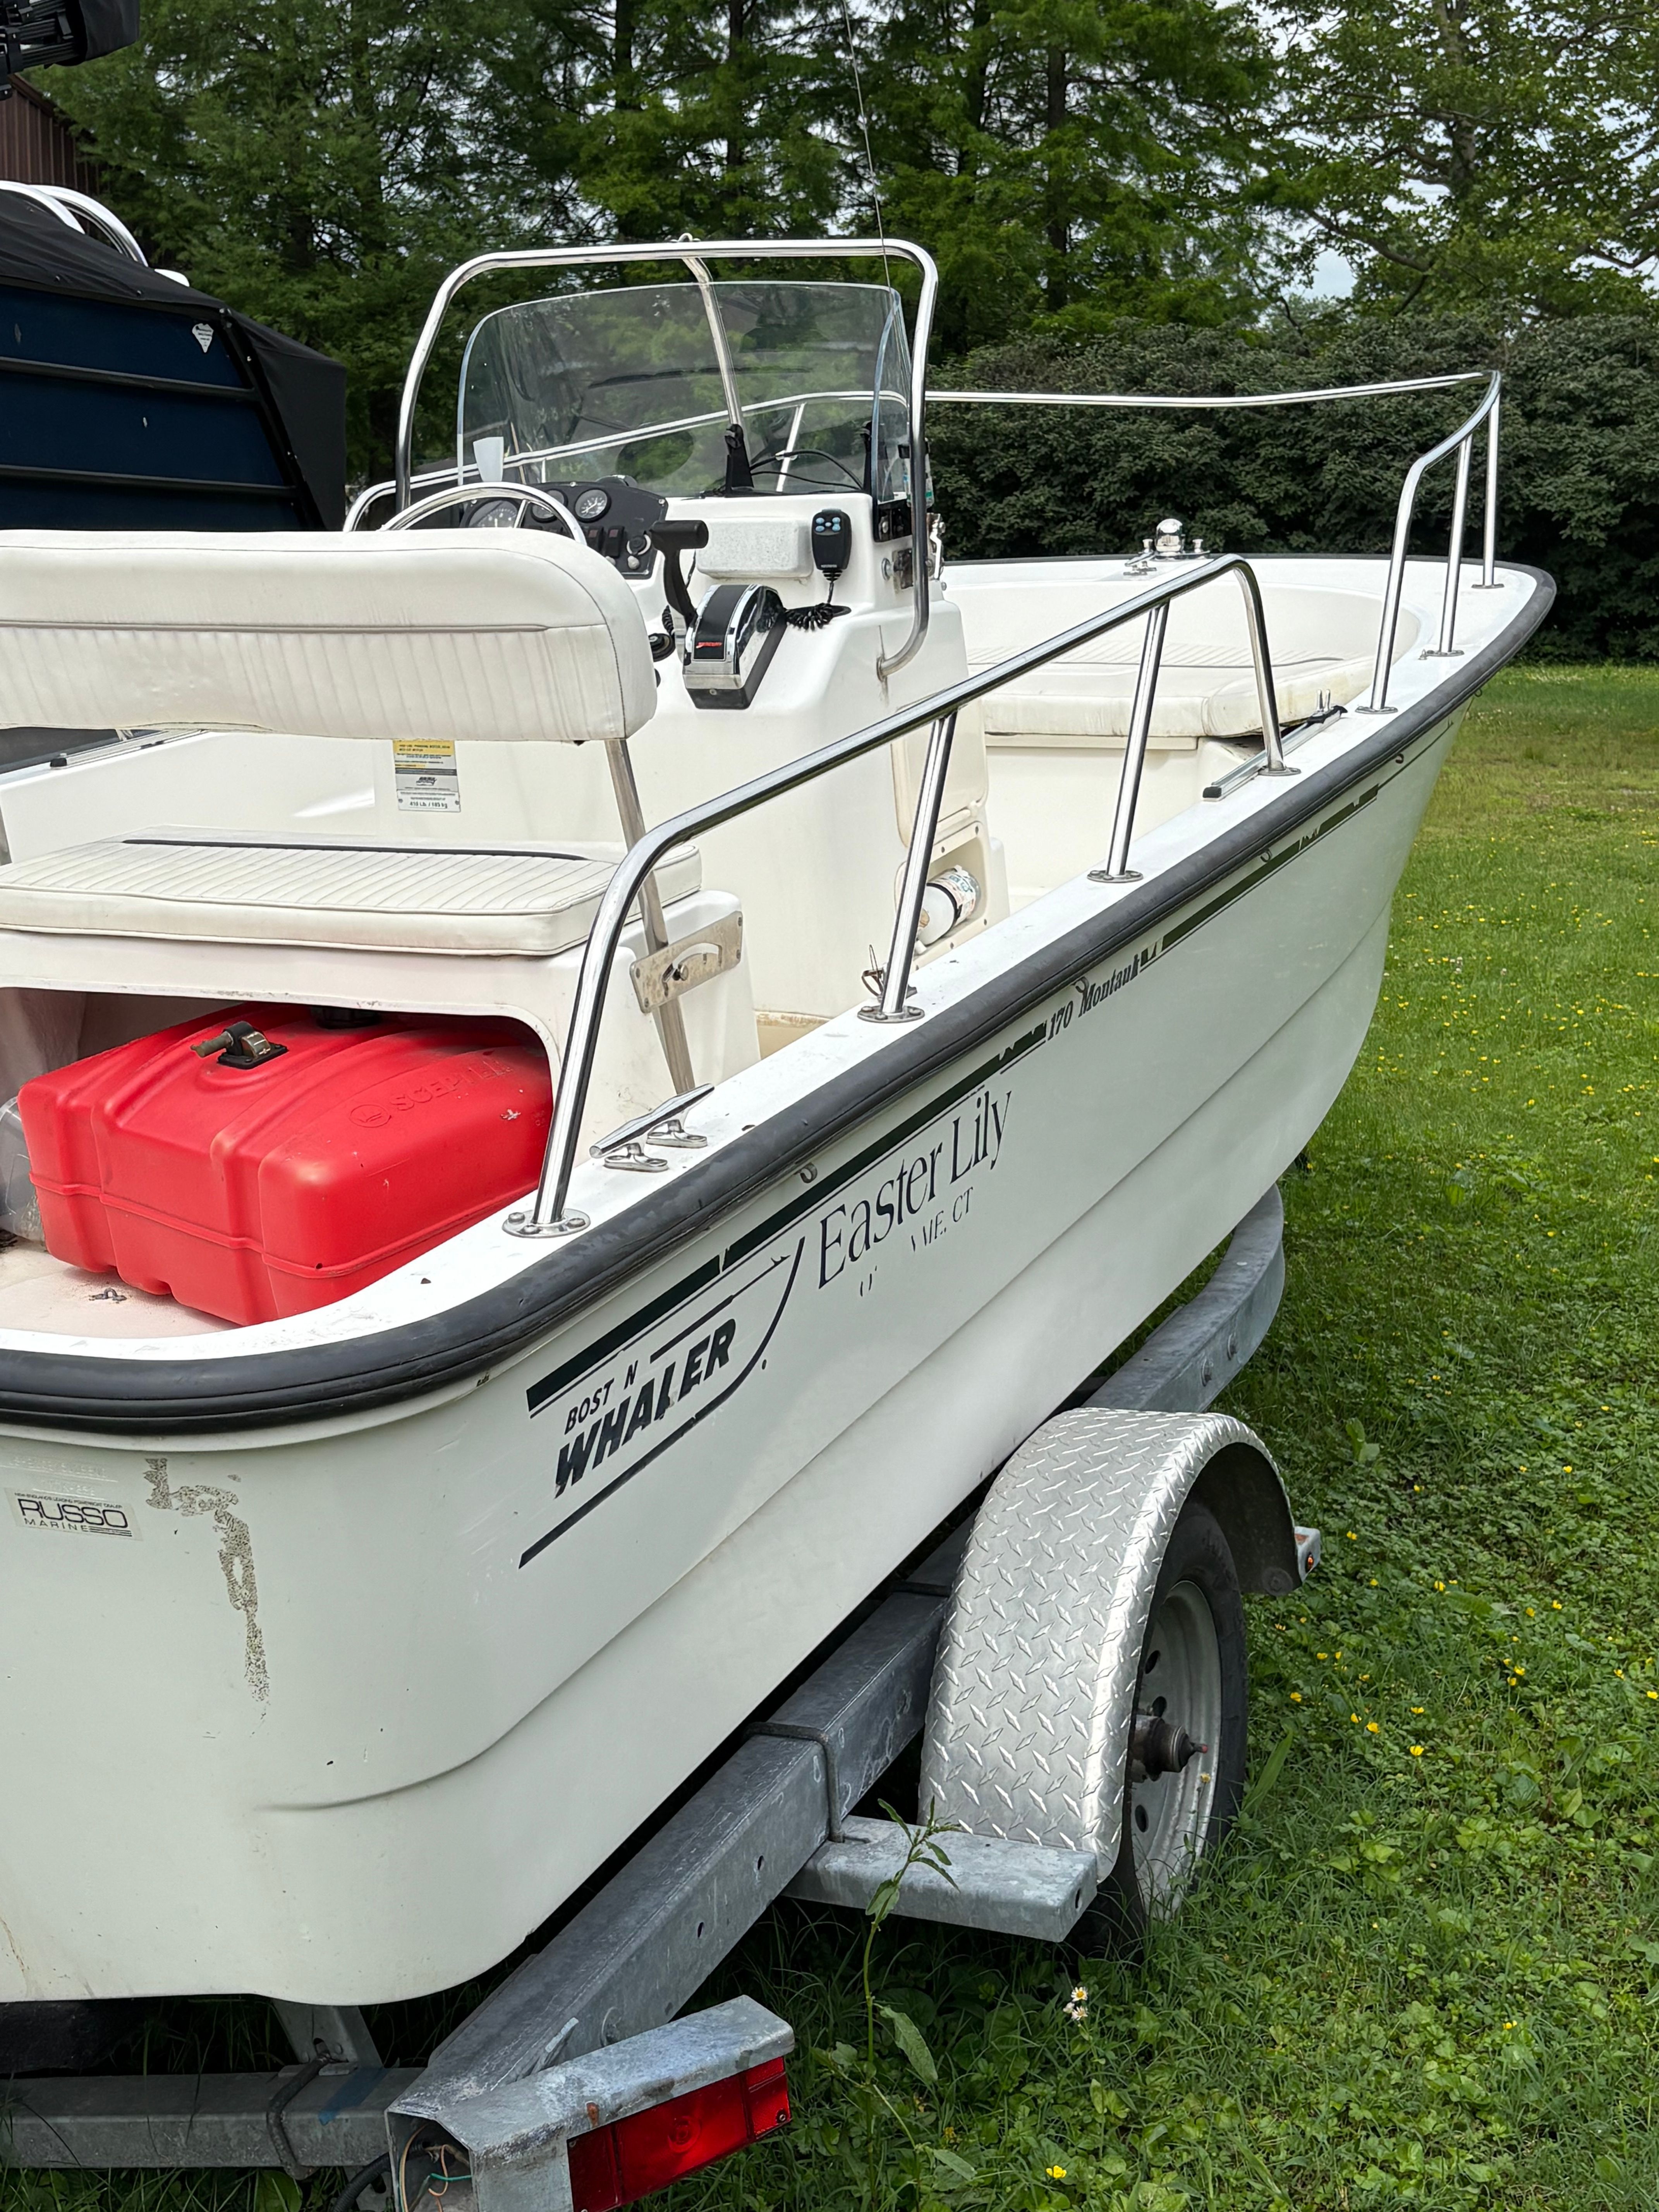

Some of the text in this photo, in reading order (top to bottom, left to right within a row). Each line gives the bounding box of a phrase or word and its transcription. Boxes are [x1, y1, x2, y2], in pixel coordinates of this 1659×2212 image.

[1048, 954, 1140, 1041] 170 Montauk
[819, 1091, 1012, 1290] Easter Lily
[951, 1186, 973, 1223] CT
[554, 1318, 736, 1499] WHALER
[564, 1360, 638, 1435] BOSTN
[18, 1498, 128, 1528] RUSSO
[24, 1517, 89, 1532] MARINE
